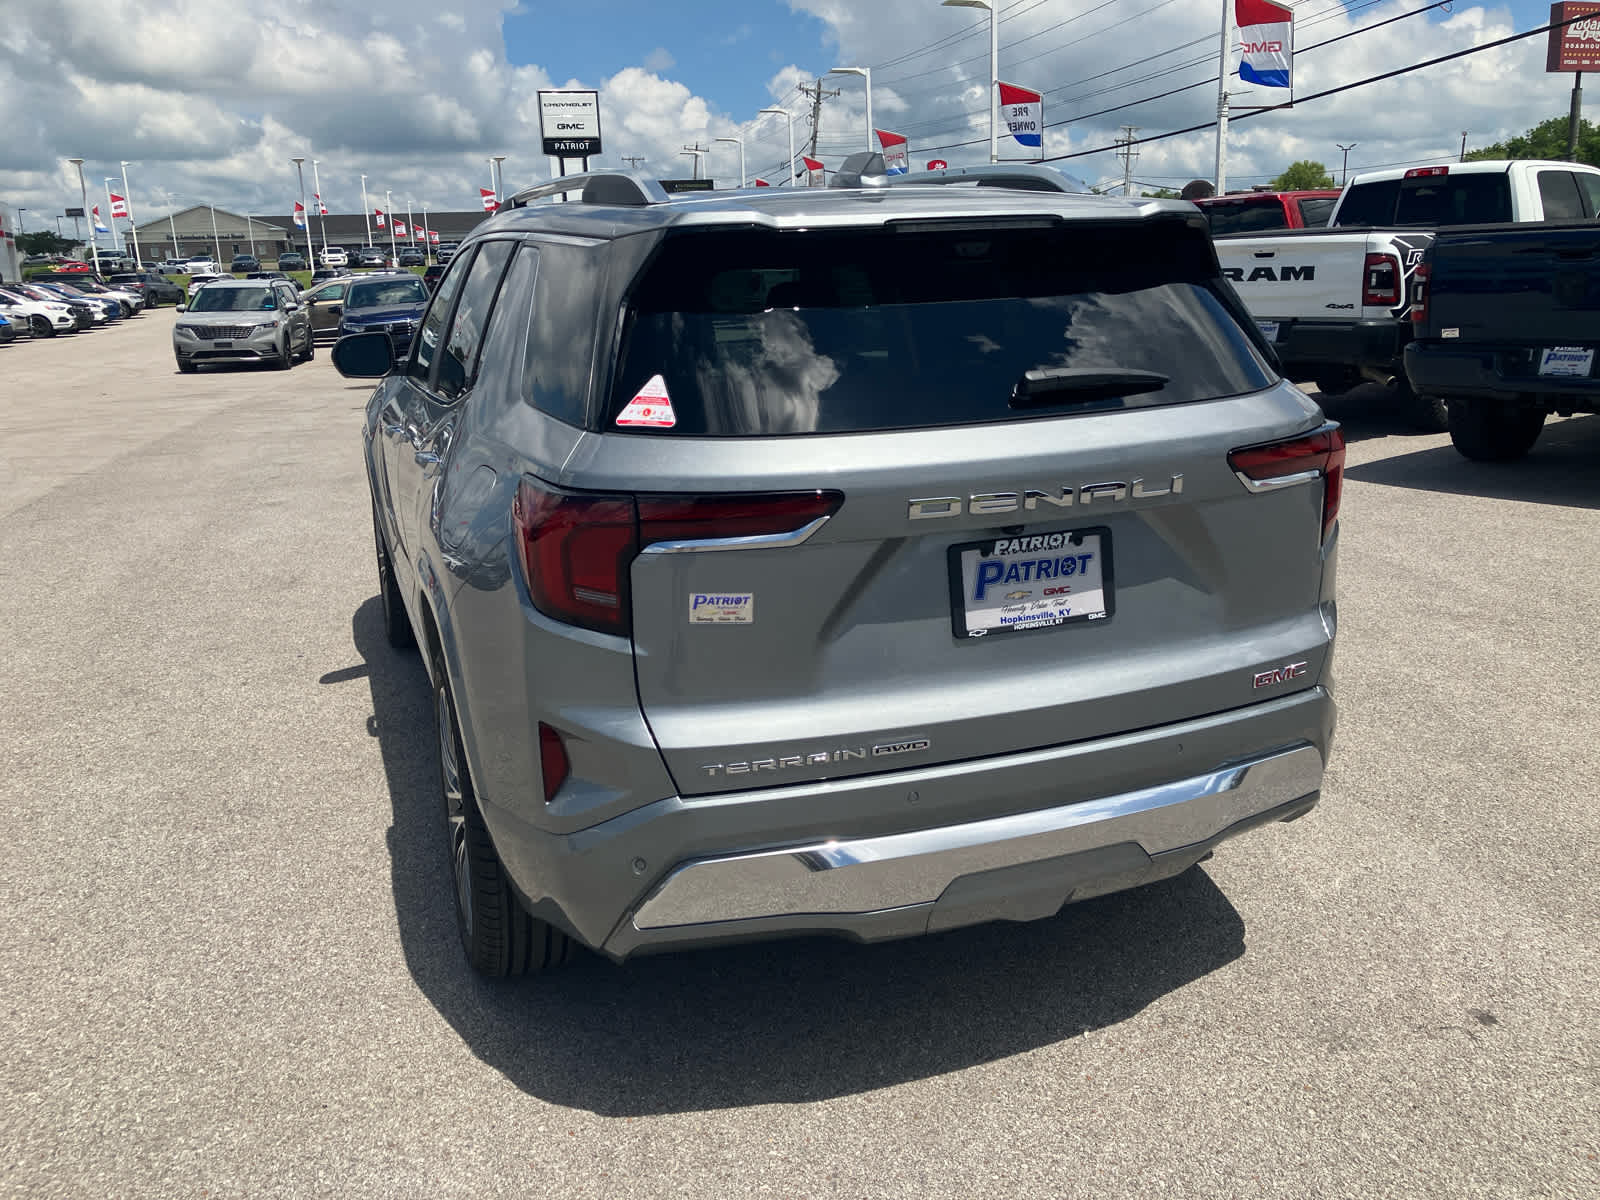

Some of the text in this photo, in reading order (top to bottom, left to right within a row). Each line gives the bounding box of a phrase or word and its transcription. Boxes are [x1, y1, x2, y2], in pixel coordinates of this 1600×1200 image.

[554, 142, 590, 150] PATRIOT
[1221, 266, 1315, 281] RAM
[908, 473, 1184, 520] DENALI
[994, 532, 1073, 555] PATRIOT
[974, 554, 1093, 600] PATRIOT
[1043, 586, 1071, 596] GMC
[692, 595, 751, 610] PATRIOT
[1000, 608, 1071, 625] Hopkinsville, KY
[1088, 612, 1106, 620] GMC
[1253, 661, 1308, 688] GMC
[702, 740, 930, 776] TERRAIN AWD
